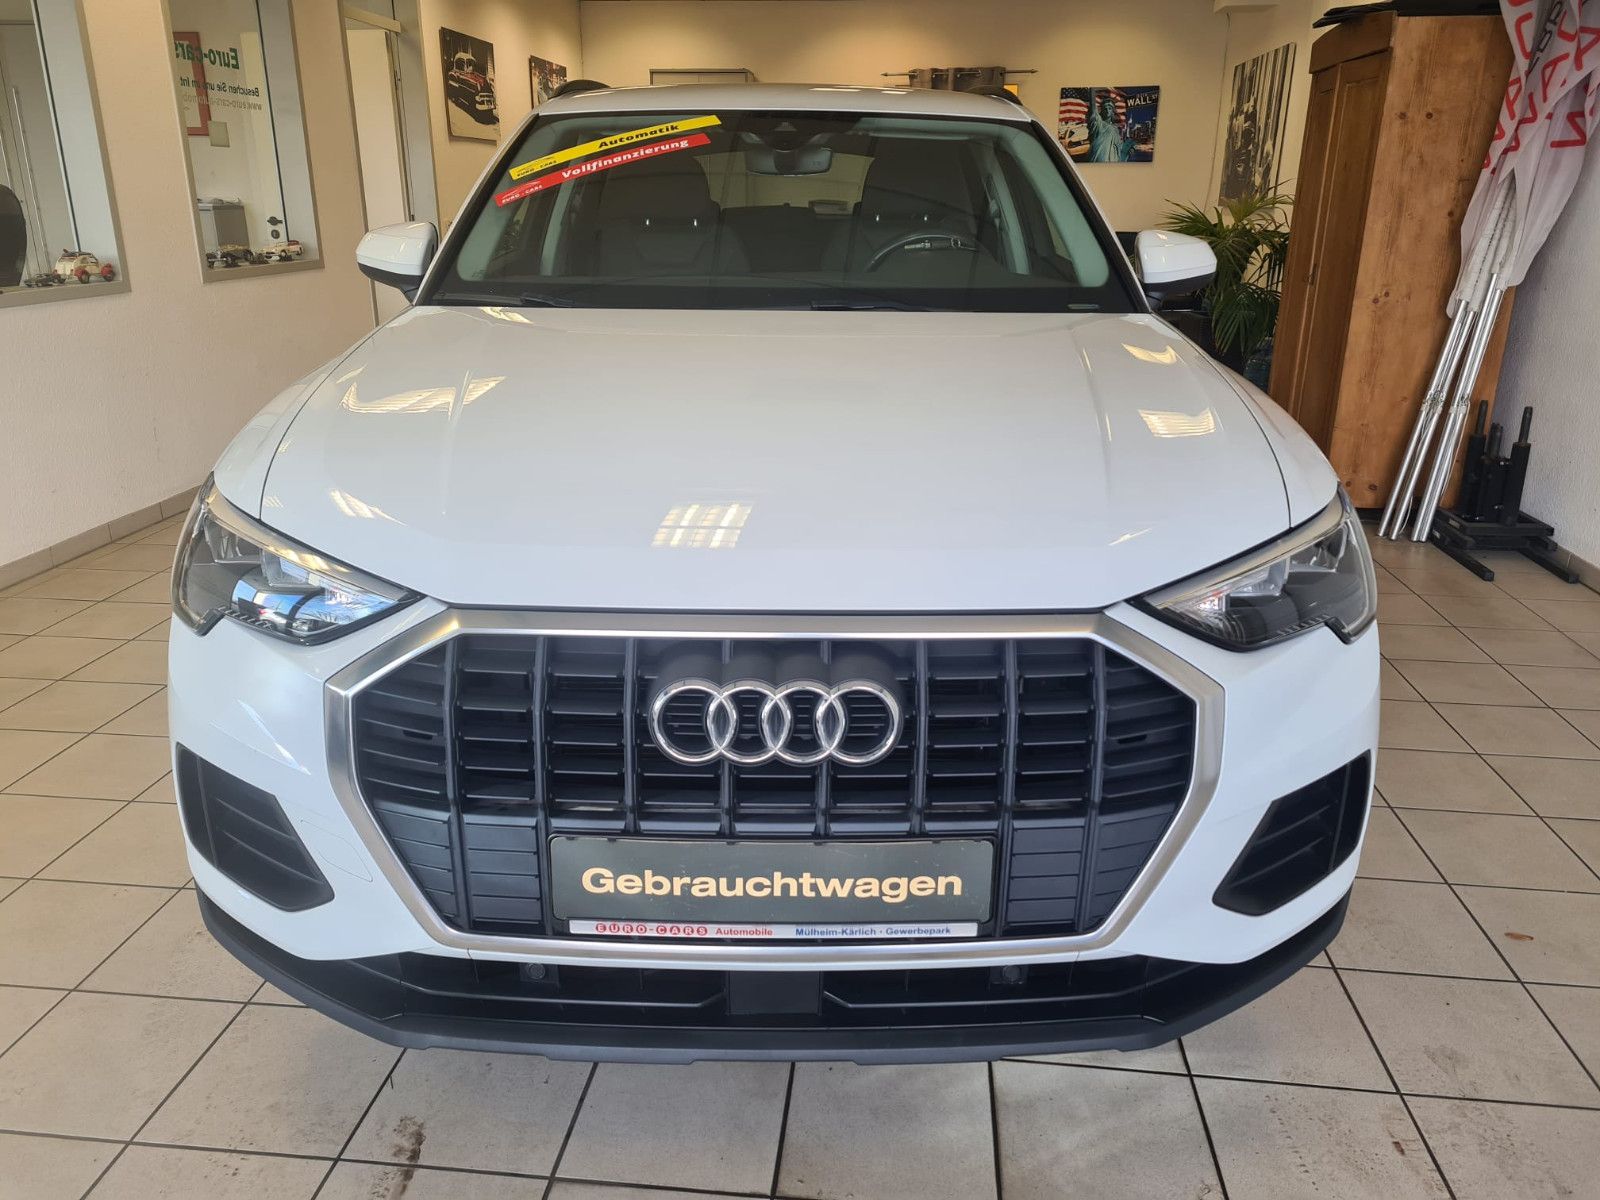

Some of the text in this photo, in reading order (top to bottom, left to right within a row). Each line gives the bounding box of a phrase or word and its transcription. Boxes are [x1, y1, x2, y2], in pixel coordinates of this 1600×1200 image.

[1126, 96, 1151, 107] WALL
[598, 124, 680, 149] Automatik
[561, 140, 690, 179] Vollfinanzierung
[581, 867, 963, 904] Gebrauchtwagen
[595, 923, 951, 937] EURO-CARS Automobile Mülheim-Kärlich Gewerbepark
